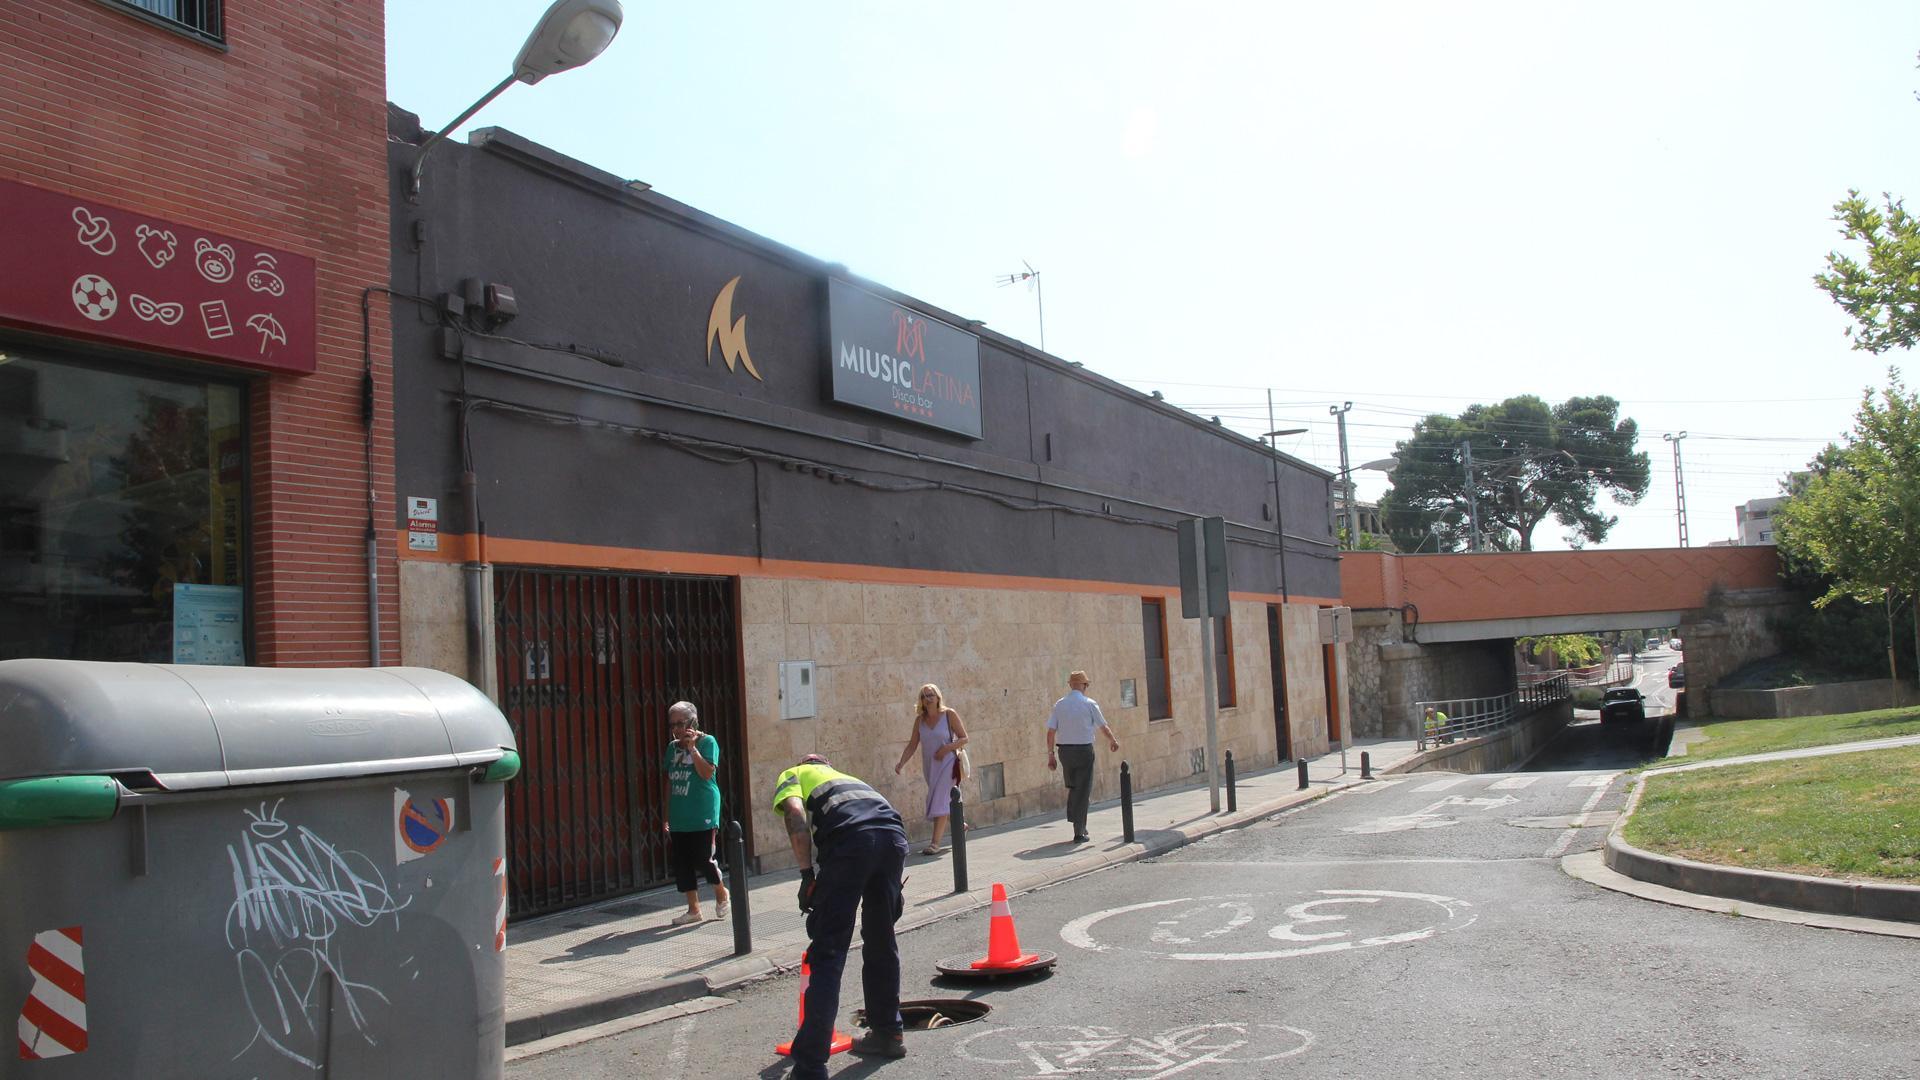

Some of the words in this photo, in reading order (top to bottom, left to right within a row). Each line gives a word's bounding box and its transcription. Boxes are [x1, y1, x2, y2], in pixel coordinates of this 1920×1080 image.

[892, 386, 915, 405] Disco
[917, 394, 933, 409] bar
[410, 520, 437, 529] Alarma
